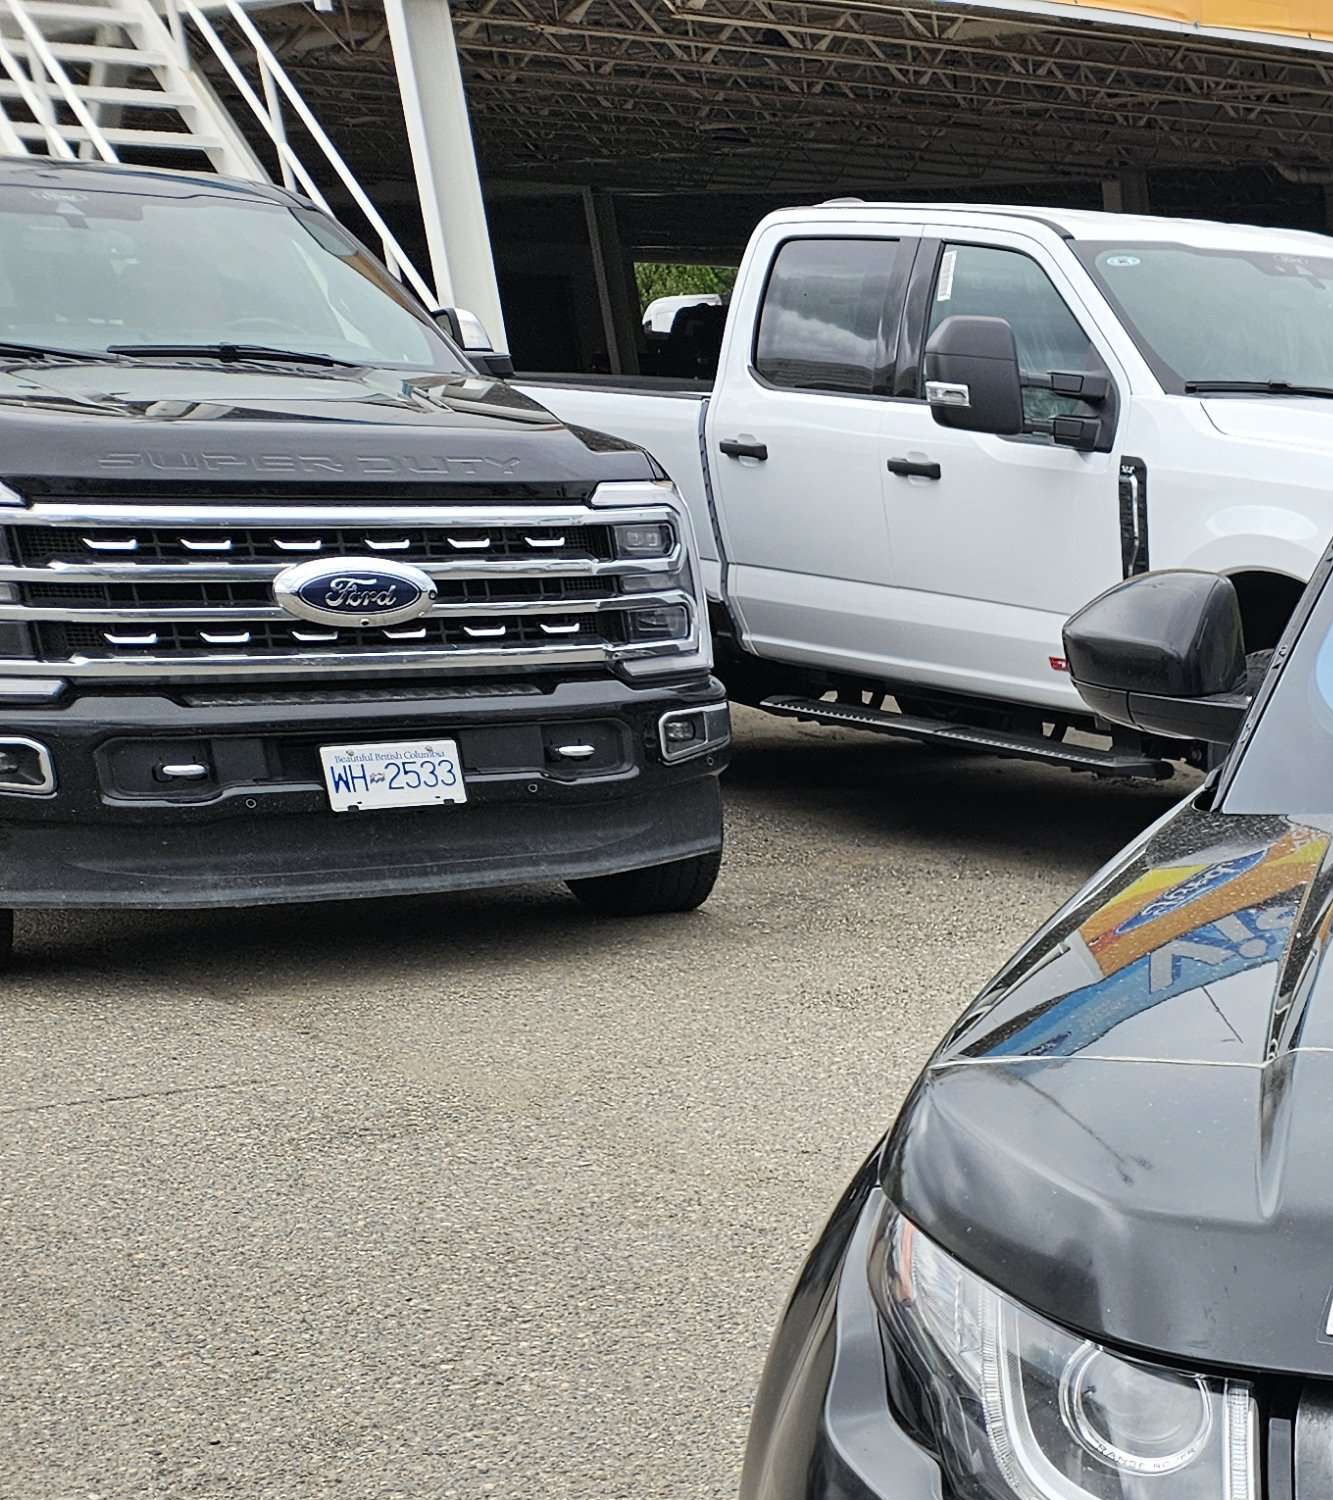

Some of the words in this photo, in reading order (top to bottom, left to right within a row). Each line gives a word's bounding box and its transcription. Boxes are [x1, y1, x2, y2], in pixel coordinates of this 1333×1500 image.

[99, 452, 345, 473] SUPER
[356, 455, 522, 475] DUTY
[325, 577, 397, 607] Ford
[334, 751, 373, 764] Beautiful
[375, 751, 403, 762] British
[404, 748, 445, 760] Columbia
